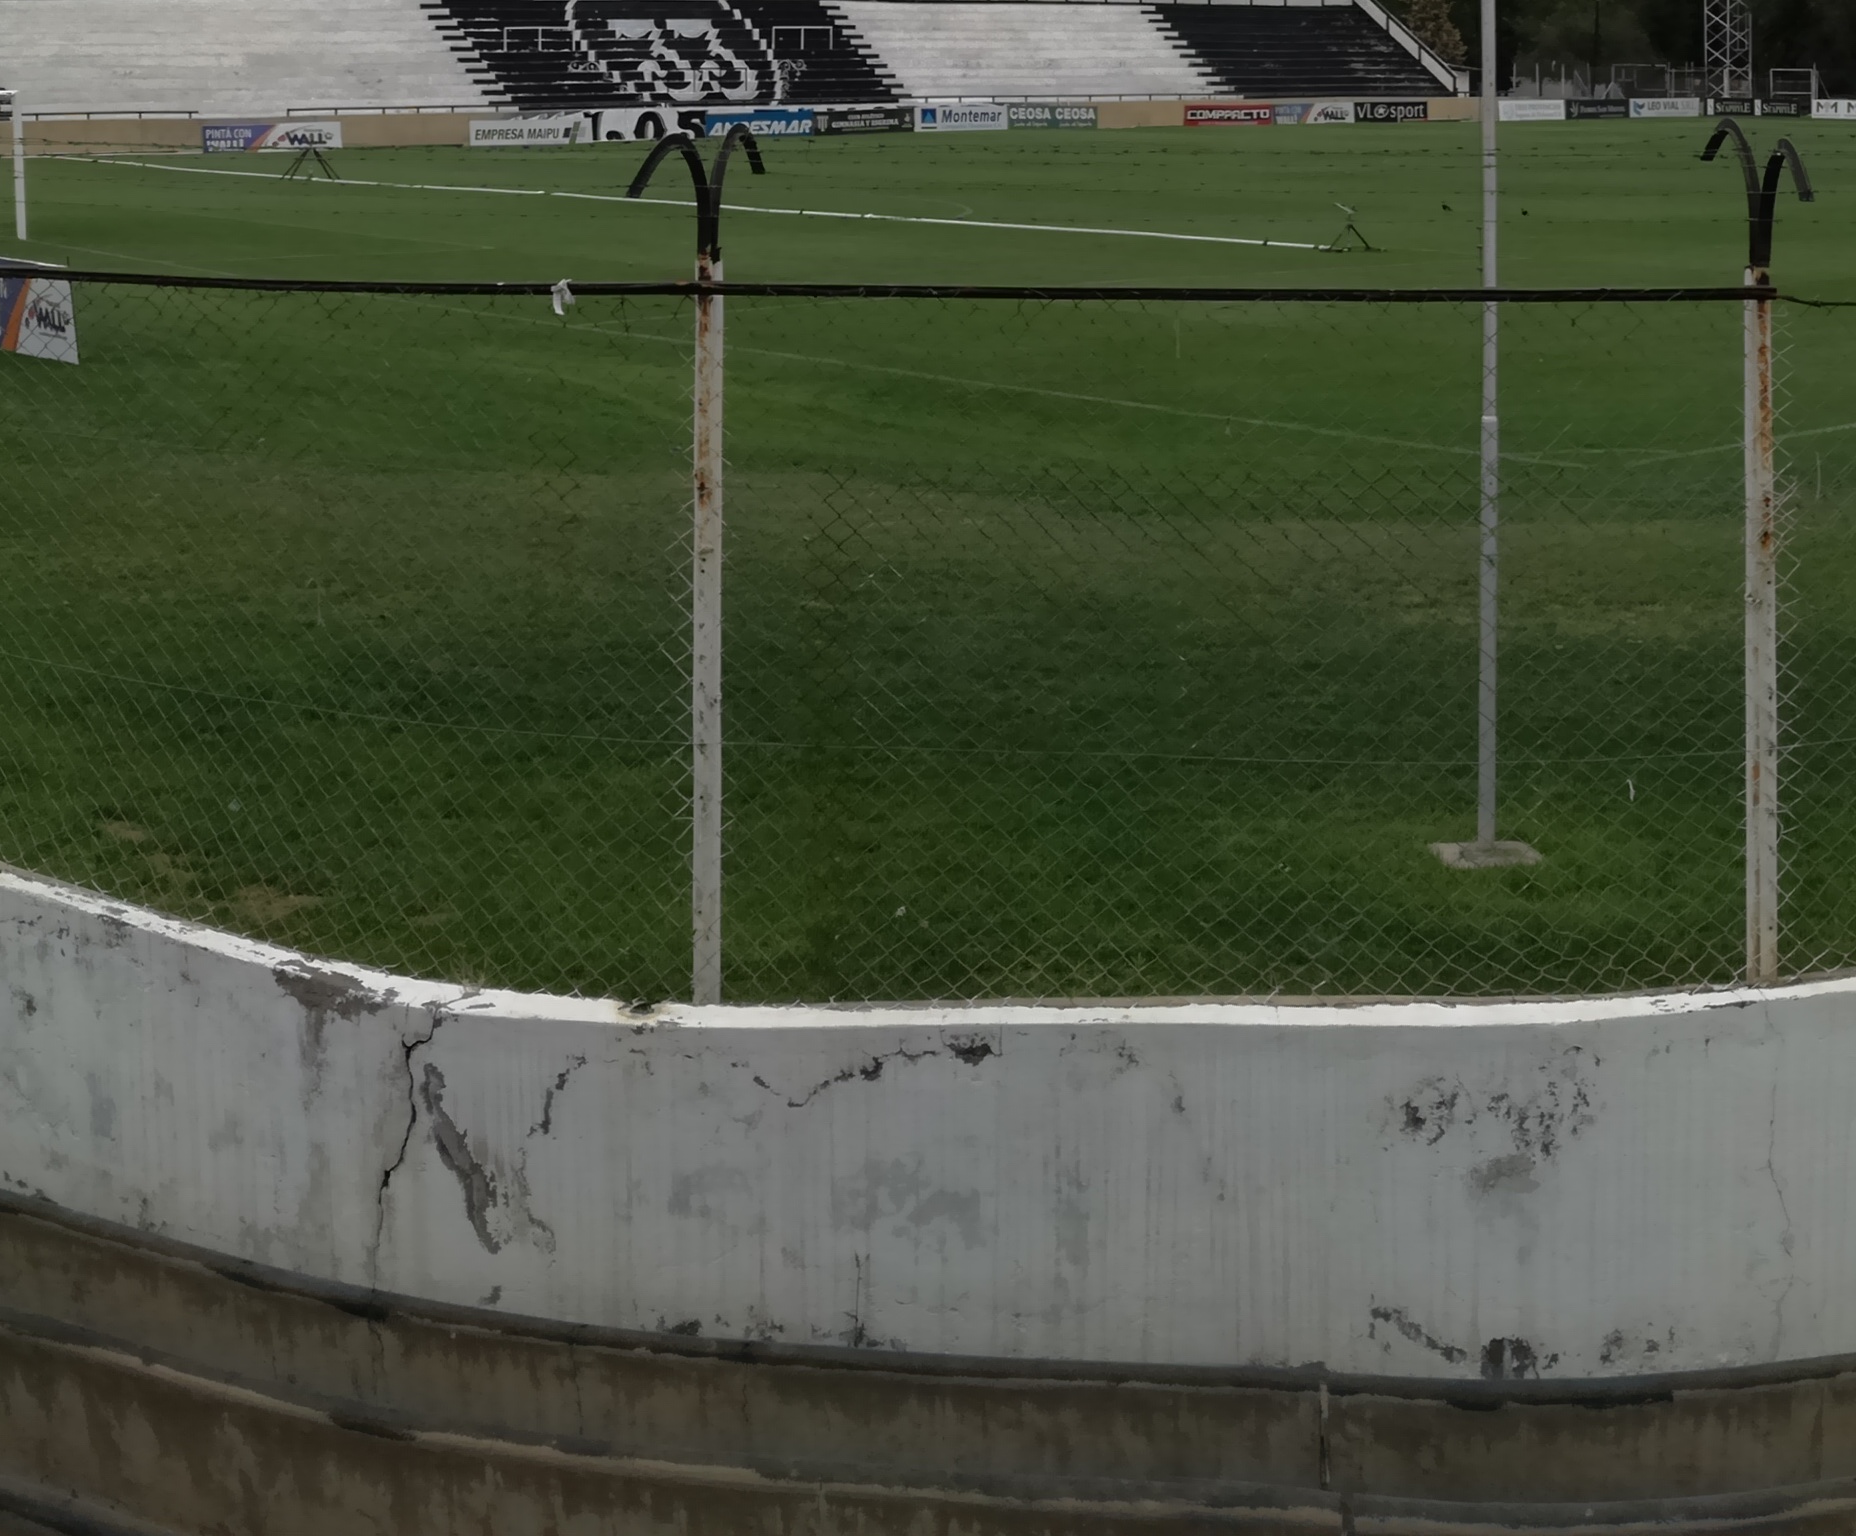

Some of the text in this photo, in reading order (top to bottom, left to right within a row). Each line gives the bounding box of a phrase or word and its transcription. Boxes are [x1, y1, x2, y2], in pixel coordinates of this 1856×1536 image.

[941, 108, 1002, 123] Montemar
[1009, 107, 1096, 119] CEOSA CEOSA
[234, 128, 252, 139] CON
[474, 128, 524, 141] EMPRESA
